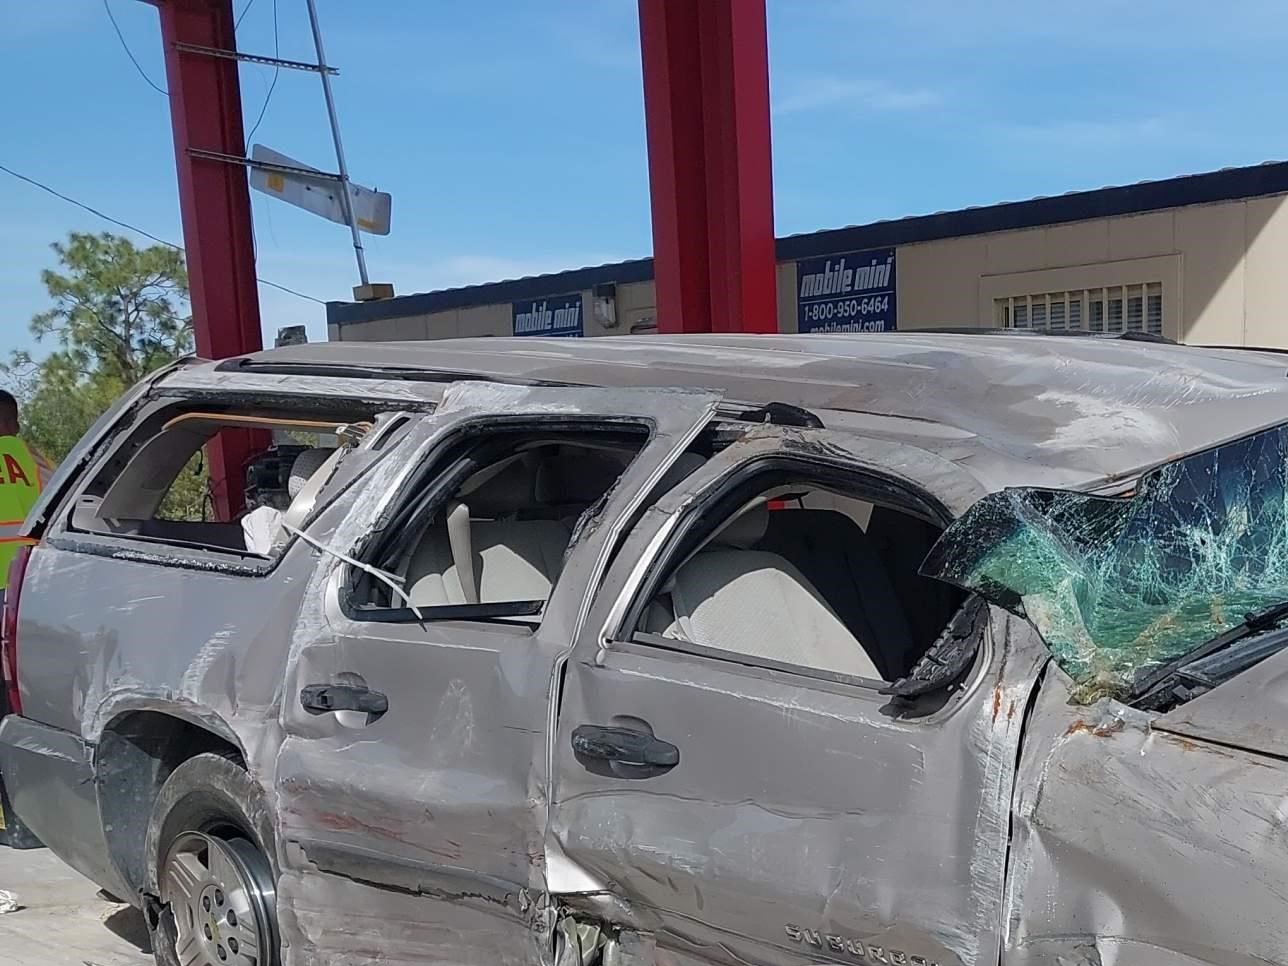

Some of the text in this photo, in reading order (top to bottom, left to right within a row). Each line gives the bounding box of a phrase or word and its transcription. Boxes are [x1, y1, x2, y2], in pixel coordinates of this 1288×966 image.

[800, 257, 892, 297] mobile mini
[515, 301, 581, 333] mobile mini
[804, 296, 889, 321] 1-800-950-6464
[0, 453, 32, 487] A
